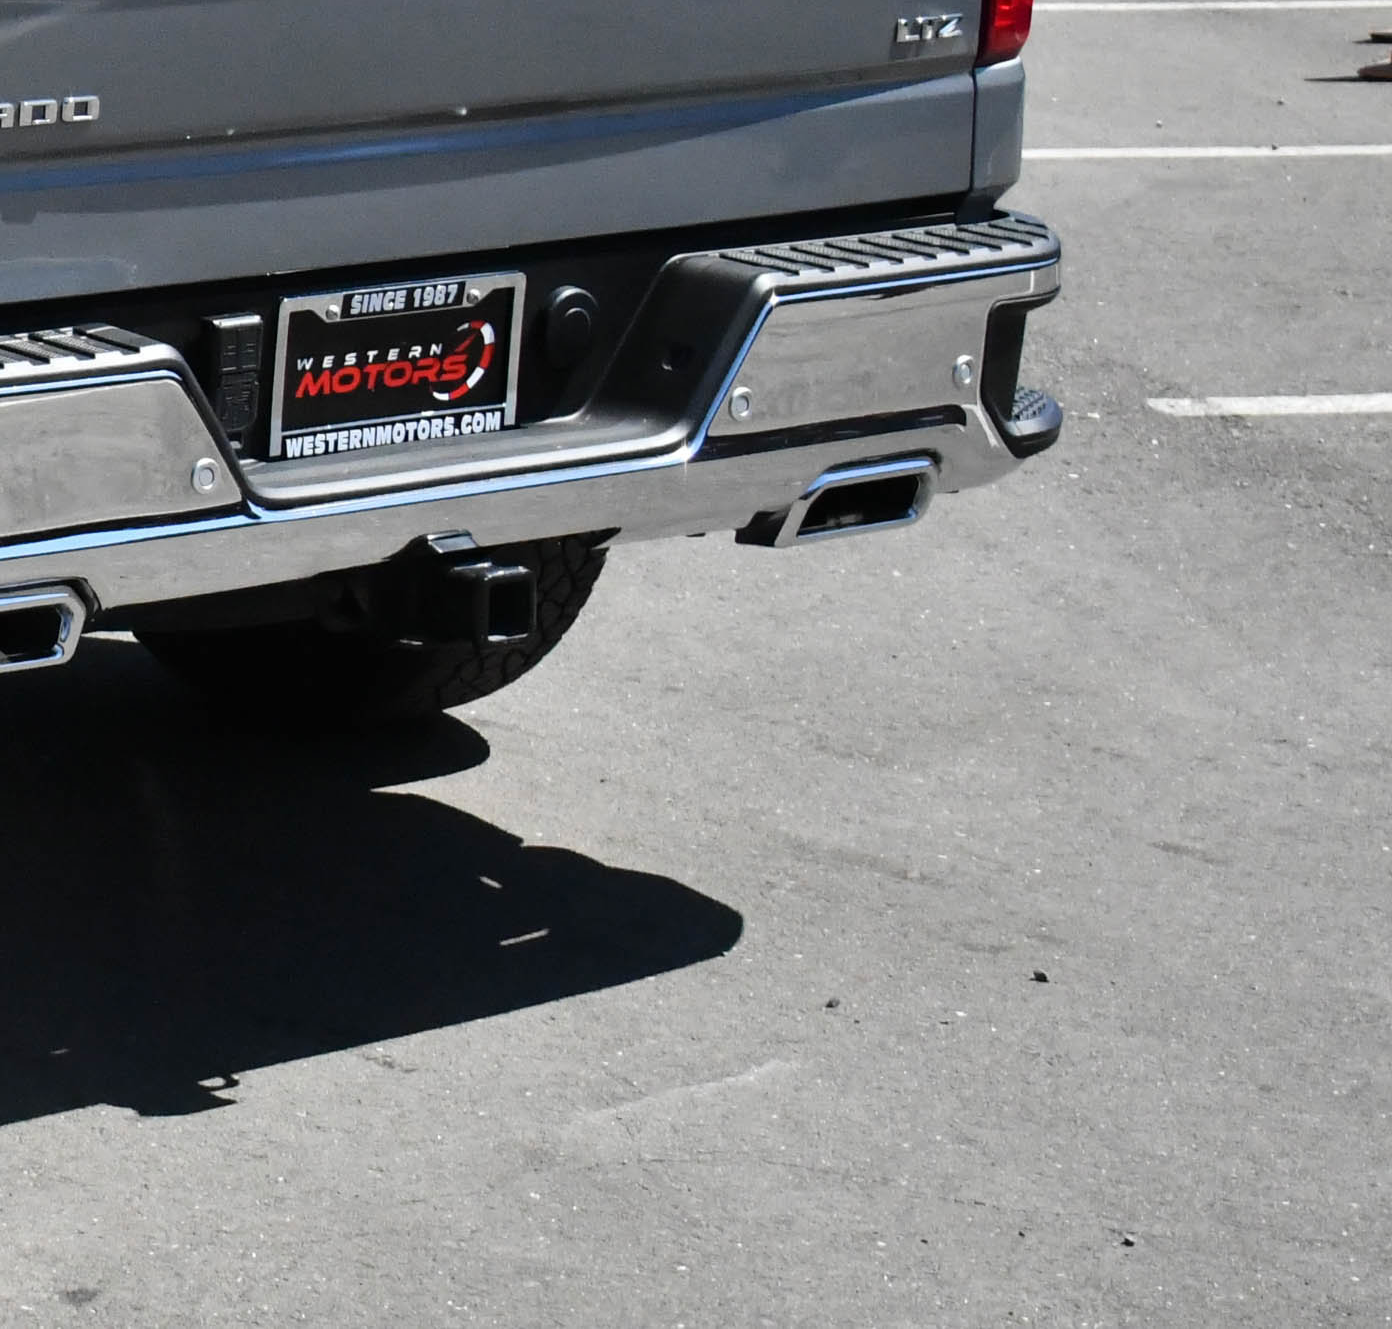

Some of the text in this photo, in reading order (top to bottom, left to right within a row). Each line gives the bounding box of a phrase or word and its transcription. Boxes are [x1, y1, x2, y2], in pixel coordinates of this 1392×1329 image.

[896, 12, 963, 43] LTZ
[349, 283, 459, 316] SINCE 1987
[296, 341, 443, 372] WESTERN
[295, 353, 470, 399] MOTORS
[284, 410, 502, 459] WESTERNMOTORS.COM
